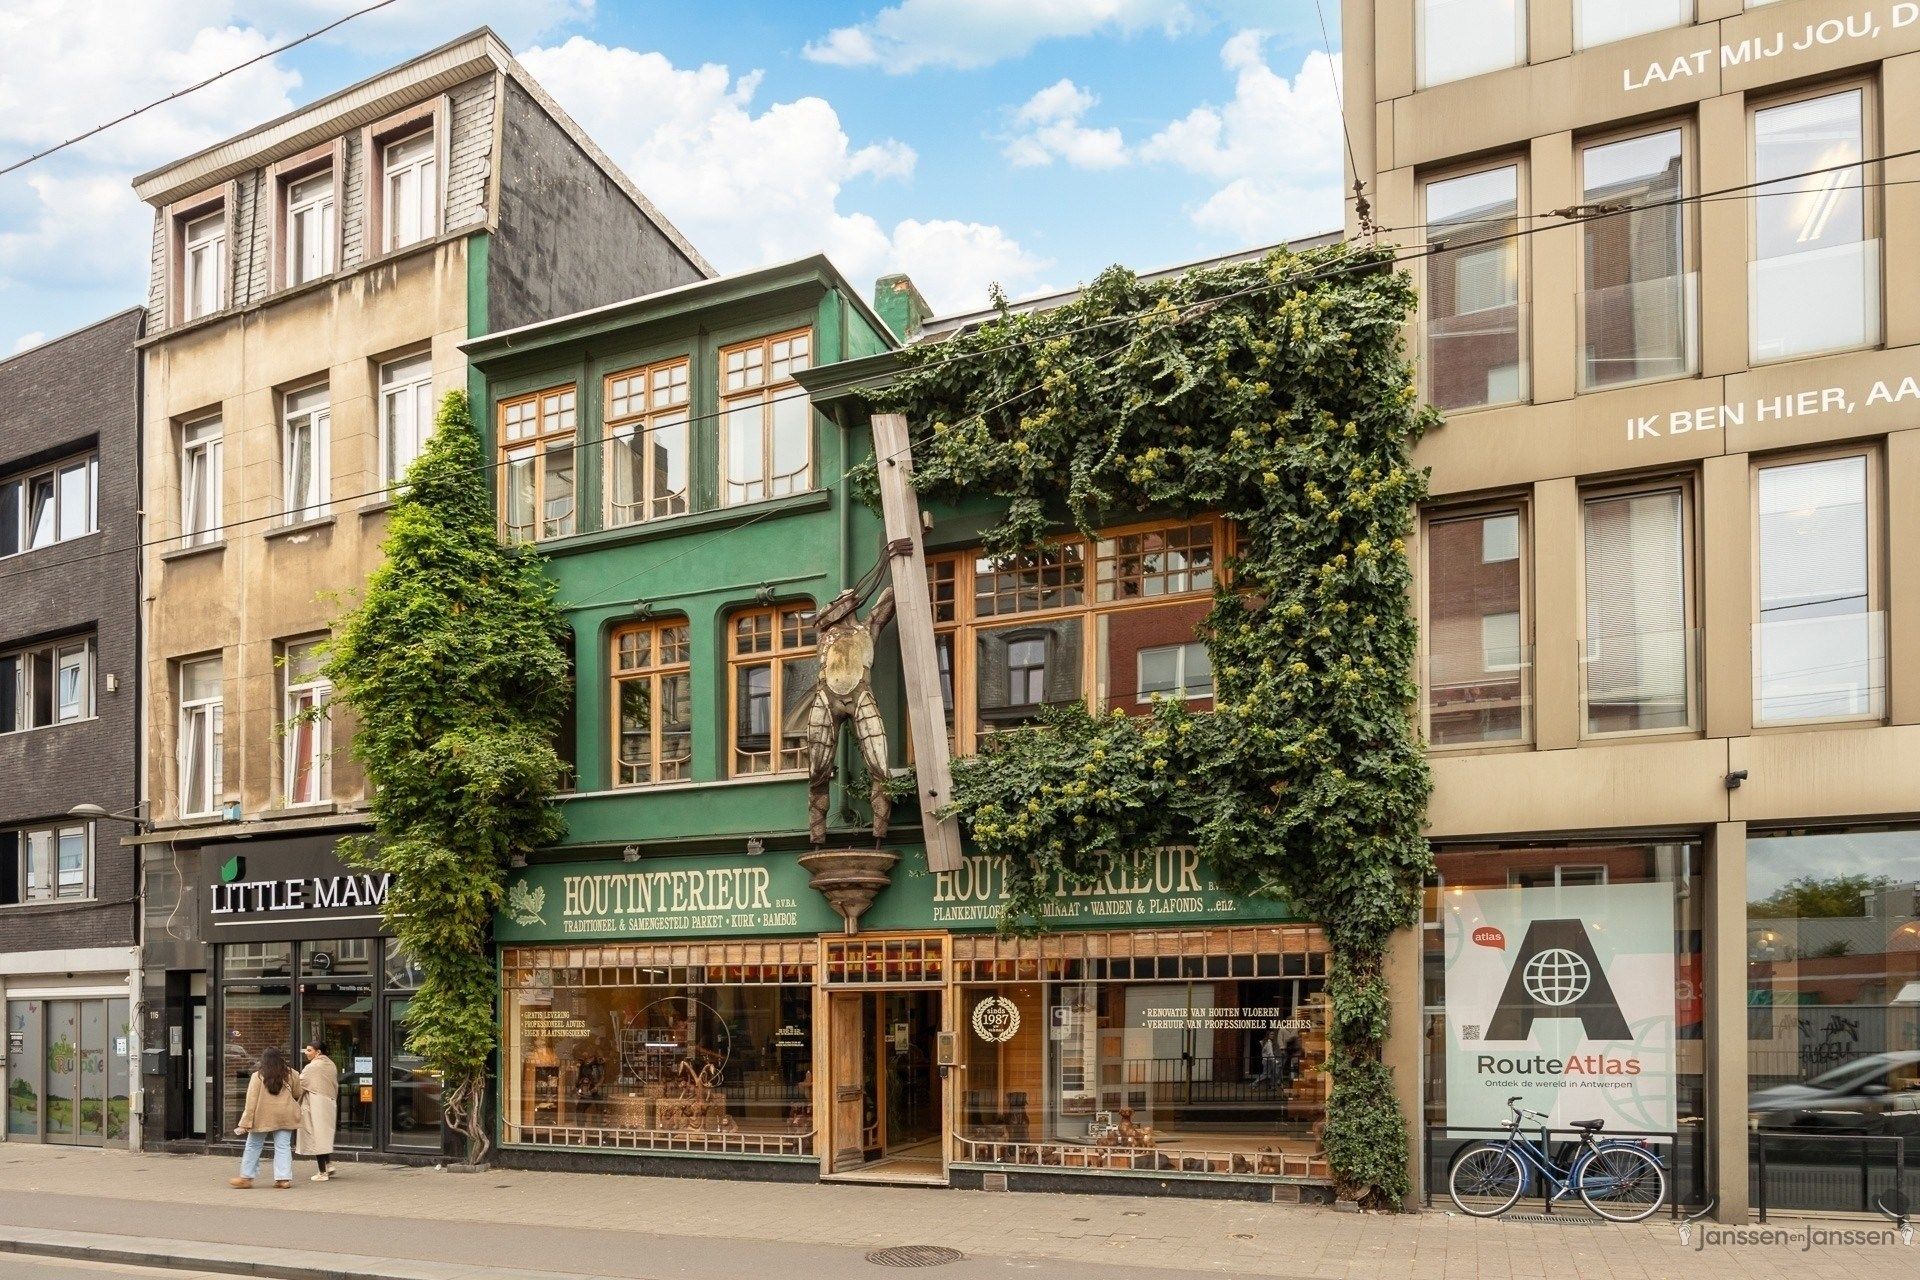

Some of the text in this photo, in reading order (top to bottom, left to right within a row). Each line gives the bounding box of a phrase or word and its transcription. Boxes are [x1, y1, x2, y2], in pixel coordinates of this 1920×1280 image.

[1623, 50, 1712, 91] LAAT
[1720, 32, 1784, 68] MIJ
[1793, 11, 1881, 51] JOU,
[1627, 415, 1661, 441] IK
[1670, 402, 1744, 435] BEN
[1757, 387, 1856, 423] HIER,
[210, 872, 390, 914] LITTLE MAM
[563, 866, 772, 916] HOUTINTERIEUR
[1091, 899, 1133, 916] WANDEN
[1136, 899, 1146, 915] &
[1150, 897, 1203, 914] PLAFONDS
[563, 912, 798, 933] TRADITIONEEL & SAMENGESTELD PARKET KURK BAMBOE
[1475, 932, 1502, 942] atlas
[524, 1011, 570, 1019] GRATIS LEVERING
[1147, 1007, 1280, 1017] RENOVATIE VAN HOUTEN VLOEREN
[524, 1020, 586, 1028] PROFESSIONEEL ADVIES
[982, 1014, 1010, 1025] 1987
[1147, 1019, 1312, 1029] VERHUUR VAN PROFESSIONELE MACHINES
[524, 1029, 591, 1037] EIGEN PLAATSINGSDIENST
[1477, 1054, 1641, 1076] RouteAtlas
[1485, 1079, 1633, 1090] Ontdek de wereld in Antwerpen
